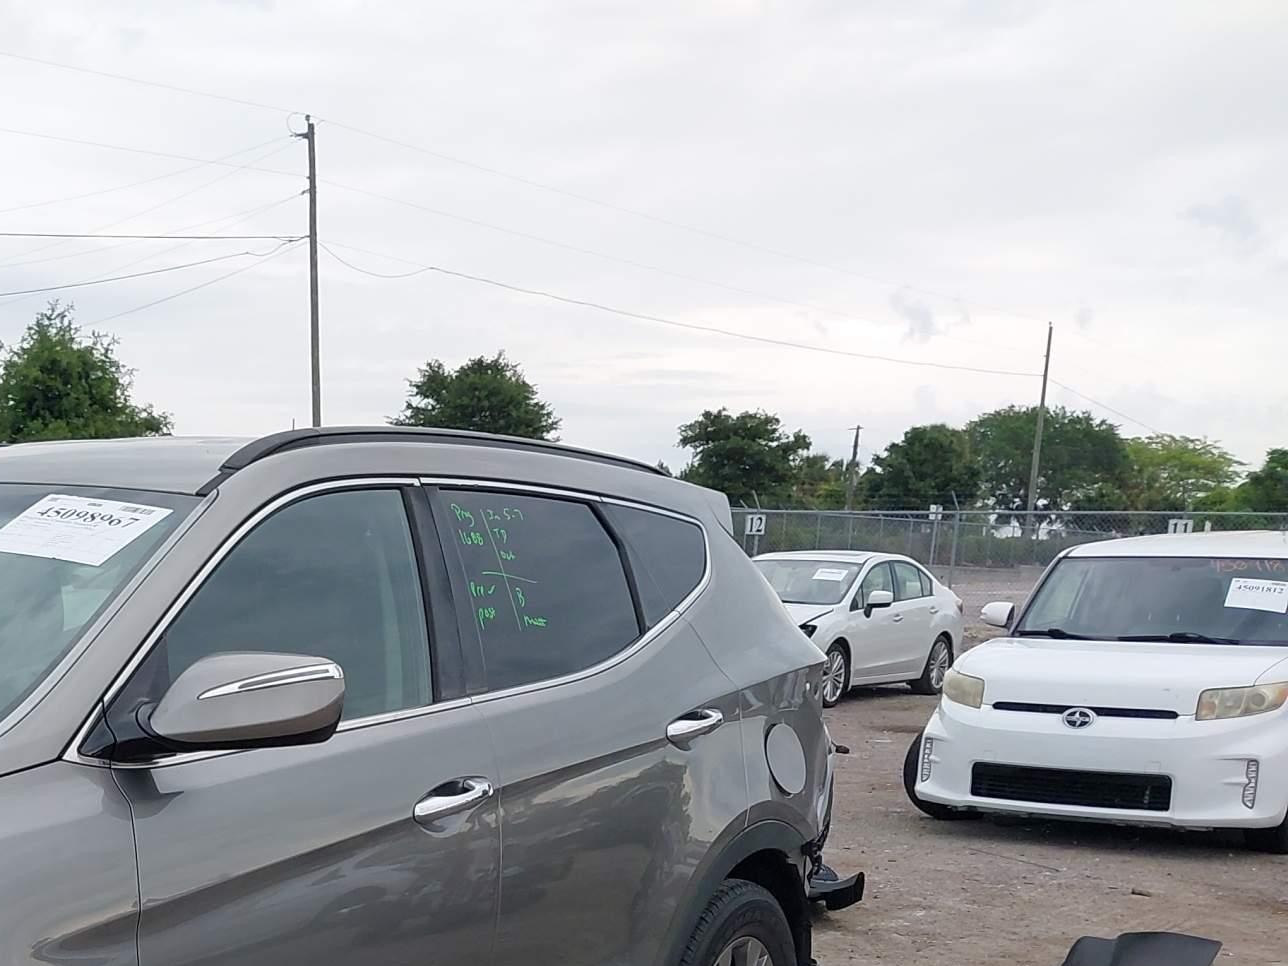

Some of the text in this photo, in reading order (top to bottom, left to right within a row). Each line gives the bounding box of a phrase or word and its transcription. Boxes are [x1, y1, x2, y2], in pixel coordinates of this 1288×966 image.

[37, 505, 140, 528] 45098967
[749, 516, 763, 533] 12
[1171, 521, 1189, 534] 11
